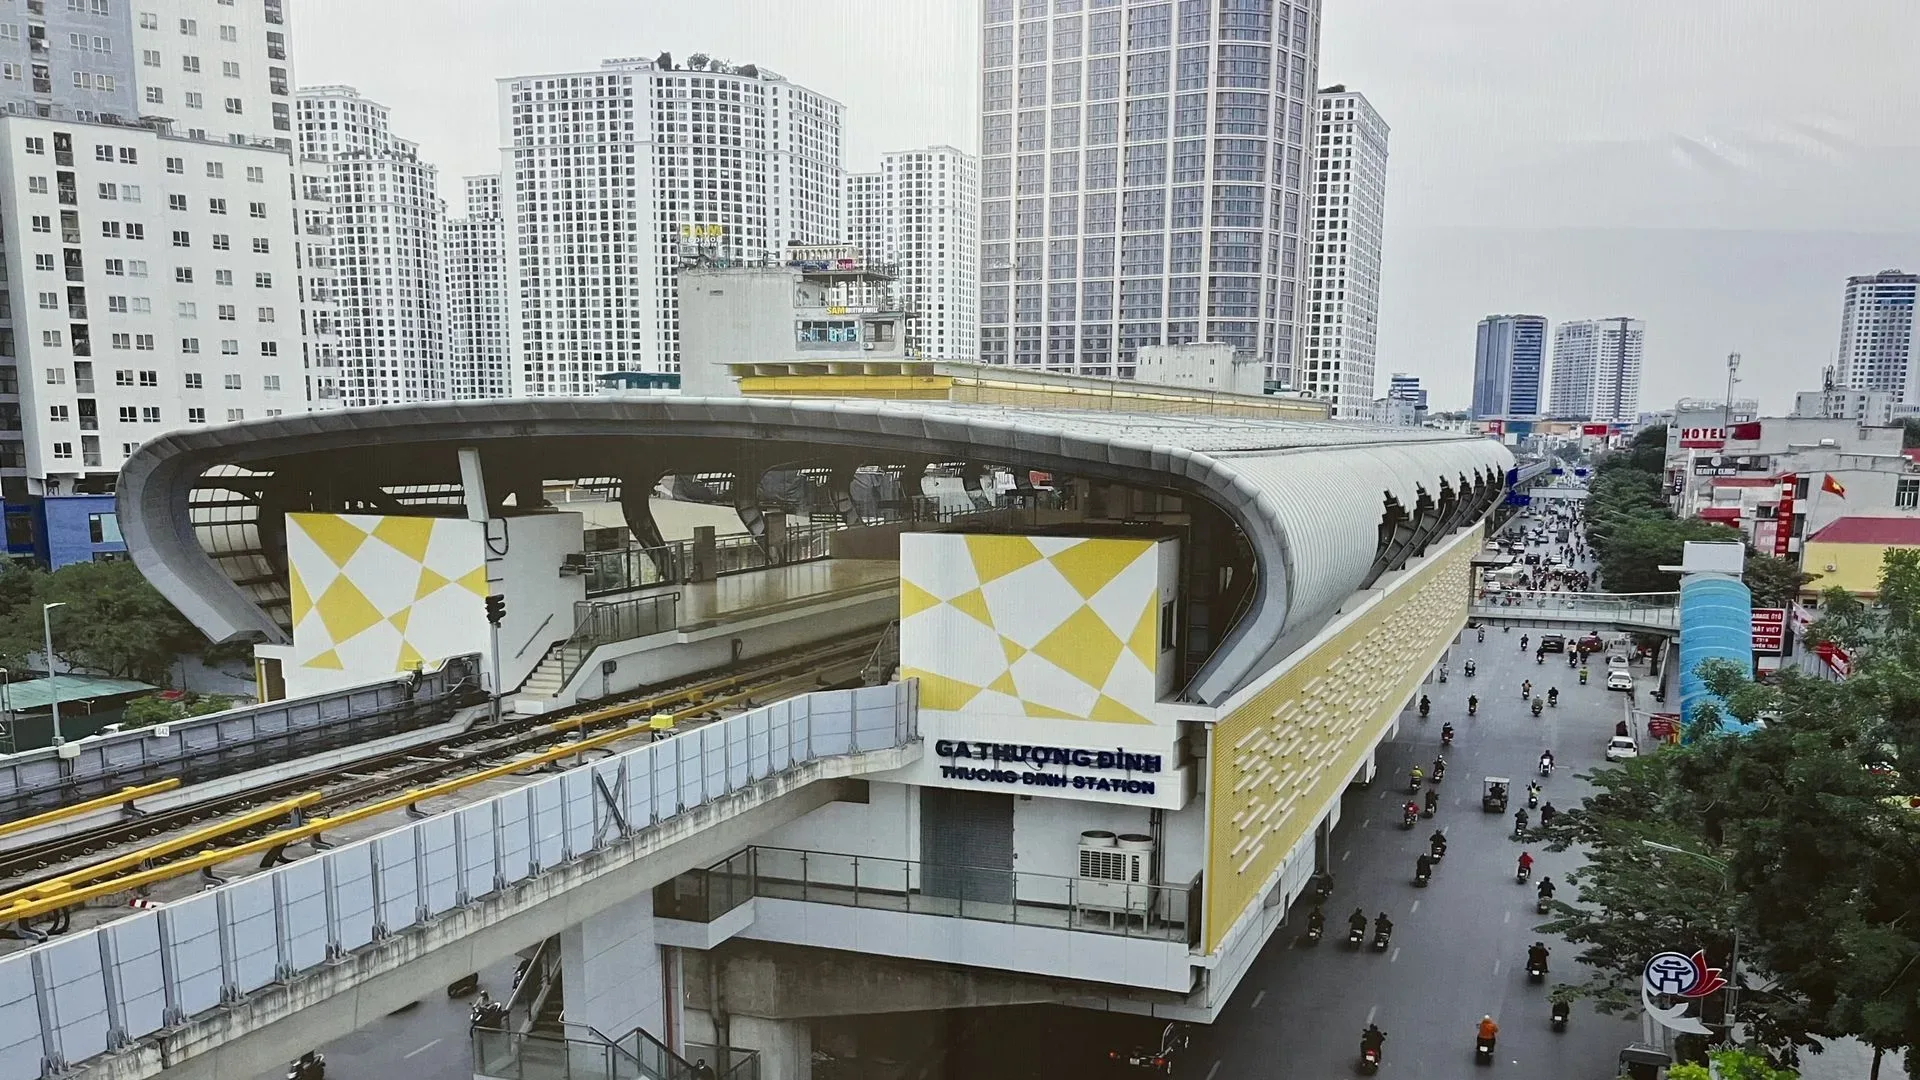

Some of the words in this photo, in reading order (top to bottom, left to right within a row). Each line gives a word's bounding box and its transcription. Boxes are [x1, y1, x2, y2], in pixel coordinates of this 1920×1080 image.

[826, 306, 846, 315] SAM
[1682, 428, 1727, 439] HOTEL
[935, 739, 971, 758] GA
[973, 742, 1091, 770] THƯỢNG
[1096, 747, 1161, 772] ĐÌNH
[940, 765, 1018, 784] THUONG
[1073, 776, 1155, 795] STATION
